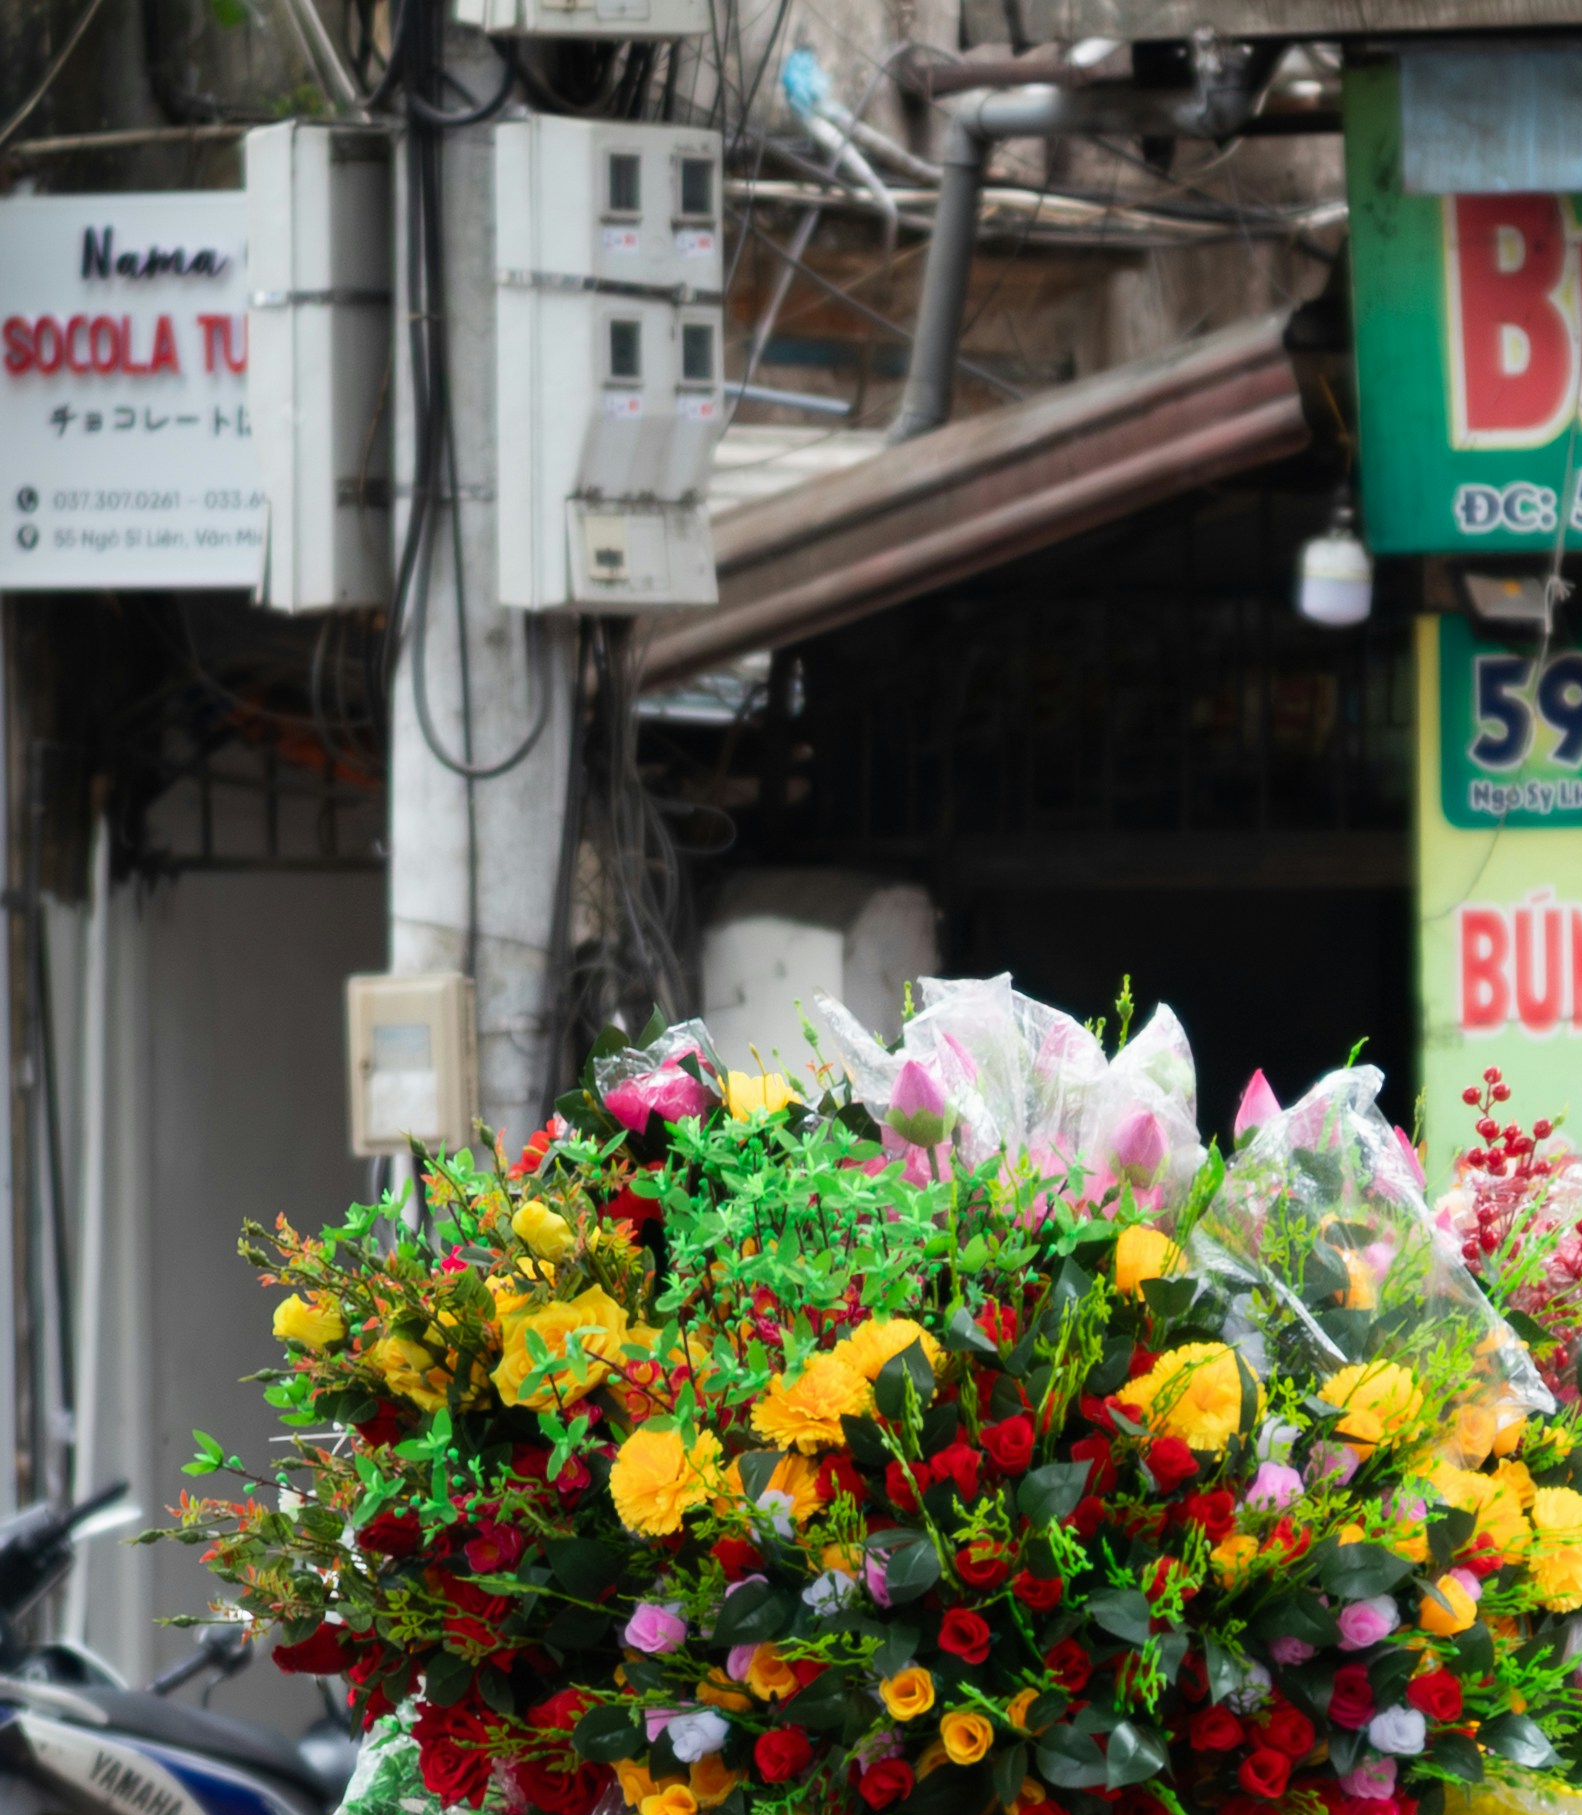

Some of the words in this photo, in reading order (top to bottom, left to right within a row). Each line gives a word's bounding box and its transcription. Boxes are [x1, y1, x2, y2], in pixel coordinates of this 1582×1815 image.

[80, 224, 230, 279] Nama
[3, 314, 181, 375] SOCOLA
[1455, 482, 1557, 534] ĐC:
